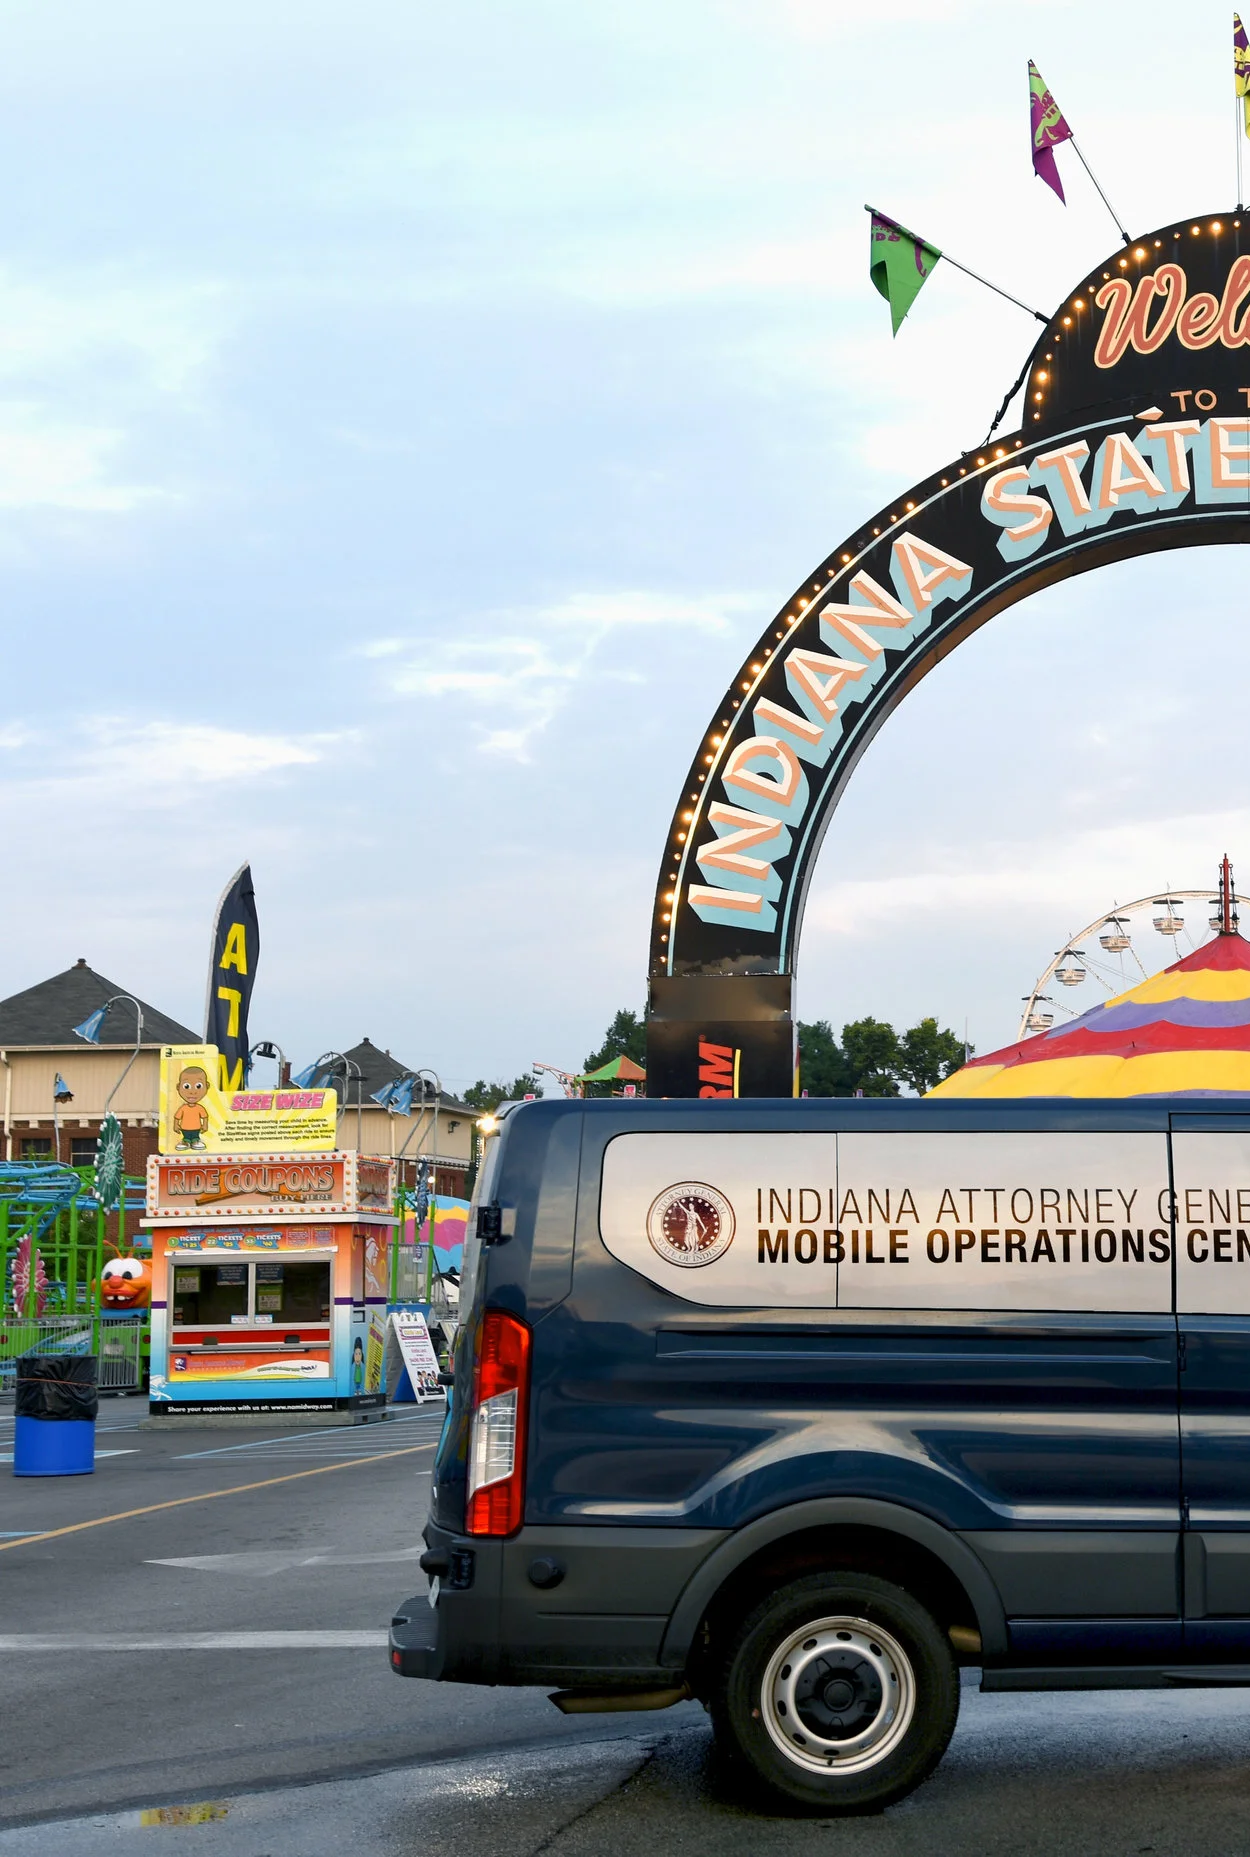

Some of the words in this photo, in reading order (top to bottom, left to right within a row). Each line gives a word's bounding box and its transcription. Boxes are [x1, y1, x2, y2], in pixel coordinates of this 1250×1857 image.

[1171, 389, 1217, 412] TO
[688, 532, 974, 932] INDIANA
[218, 923, 248, 1091] ATM
[230, 1094, 274, 1111] SIZE
[275, 1092, 325, 1110] WIZE
[168, 1168, 220, 1195] RIDE
[225, 1165, 335, 1193] COUPONS
[656, 1188, 693, 1216] ATTORNEY
[694, 1188, 727, 1215] GENERAL
[757, 1188, 920, 1223] INDIANA
[935, 1188, 1138, 1224] ATTORNEY
[657, 1237, 677, 1258] STATE
[693, 1239, 725, 1262] INDIANA
[757, 1229, 909, 1264] MOBILE
[926, 1228, 1171, 1263] OPERATIONS
[202, 1405, 237, 1413] experience
